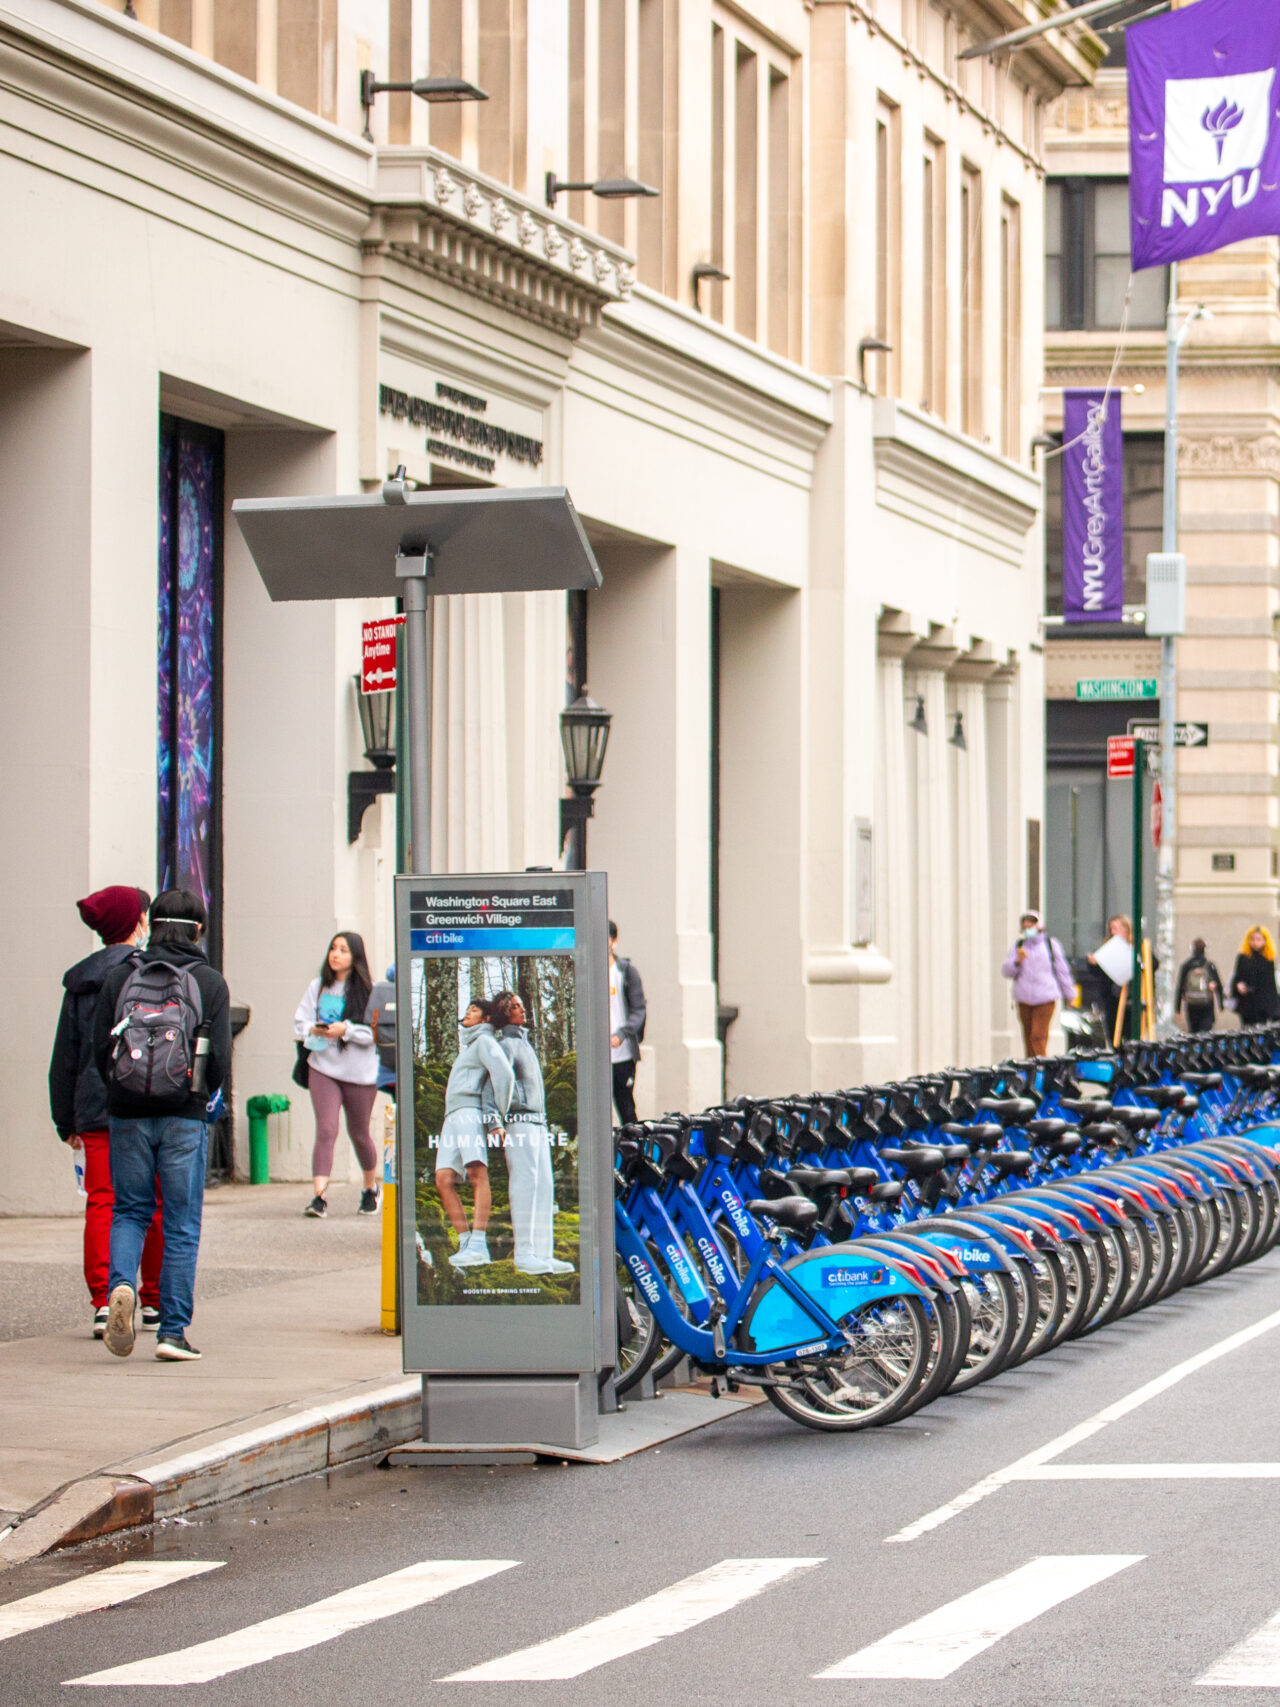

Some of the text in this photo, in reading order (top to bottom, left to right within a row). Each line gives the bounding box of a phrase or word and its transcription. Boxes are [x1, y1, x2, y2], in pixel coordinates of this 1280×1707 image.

[1161, 168, 1261, 228] NYU
[363, 625, 396, 642] NO STANDI
[364, 642, 391, 659] Anytime
[1080, 681, 1144, 698] WASHINGTON
[425, 895, 557, 909] Washington Square East
[425, 913, 522, 926] Greenwich Village
[504, 1112, 548, 1124] GOOSE
[428, 1132, 569, 1149] HUMANATURE
[963, 1249, 991, 1264] bike
[828, 1268, 869, 1283] citibank
